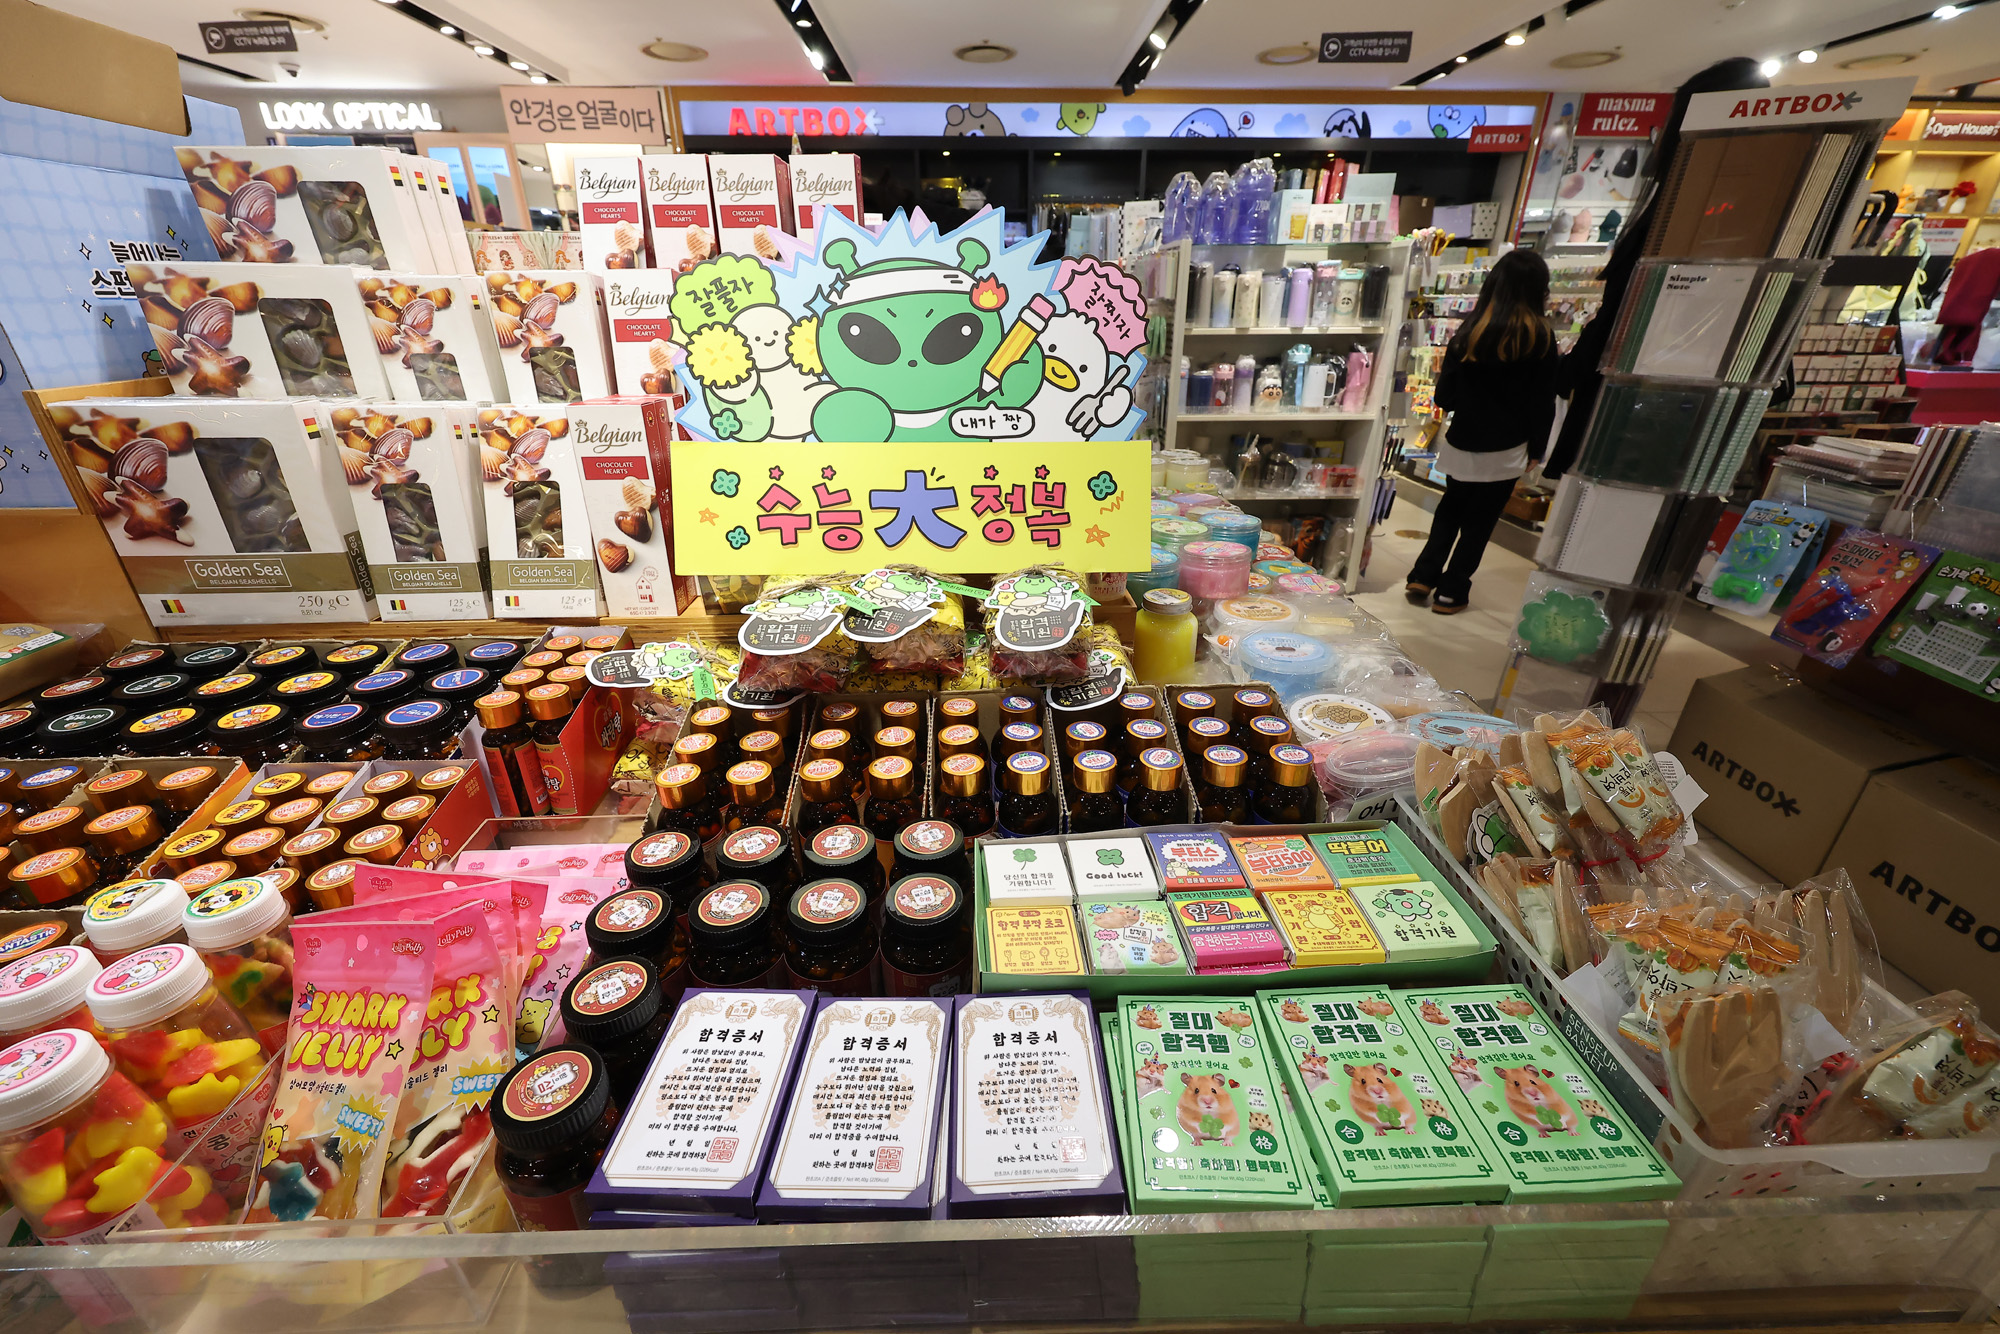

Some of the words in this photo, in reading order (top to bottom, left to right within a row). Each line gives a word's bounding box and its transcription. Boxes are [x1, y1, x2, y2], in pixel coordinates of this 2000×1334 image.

[1597, 97, 1656, 113] masma
[1729, 92, 1863, 118] ARTBOX
[259, 101, 332, 130] LOOK
[333, 101, 442, 130] OPTICAL
[510, 98, 577, 133] 안경은
[577, 100, 655, 133] 얼굴이다
[728, 106, 886, 136] ARTBOX
[1933, 122, 1959, 137] Orgel
[1963, 123, 1994, 135] House
[1473, 133, 1524, 145] ARTBOX
[579, 174, 637, 199] Belgian
[648, 173, 706, 202] Belgian
[716, 172, 774, 202] Belgian
[795, 173, 853, 202] Belgian
[594, 206, 636, 215] CHOCOLATE
[664, 209, 697, 217] CHOCOLATE
[1668, 274, 1707, 284] Simple
[686, 274, 754, 318] 잘풀자
[960, 415, 996, 431] 내가
[1003, 413, 1022, 435] 짱
[577, 423, 643, 453] Belgian
[756, 475, 864, 550] 수능
[971, 475, 1071, 548] 정복
[1838, 543, 1883, 562] 스파이더
[194, 562, 251, 578] Golden
[253, 562, 284, 576] Sea
[394, 571, 435, 581] Golden
[437, 569, 457, 580] Sea
[513, 567, 552, 577] Golden
[554, 568, 573, 576] Sea
[1937, 565, 1969, 581] 손가락
[358, 561, 374, 597] Golden
[299, 596, 324, 608] 250
[768, 624, 798, 633] 합격
[1020, 617, 1049, 629] 합격
[766, 634, 796, 643] 기원
[1022, 629, 1051, 639] 기원
[1691, 740, 1801, 818] ARTBOX
[1359, 800, 1387, 820] OH
[1171, 847, 1219, 857] 부터스
[1327, 840, 1390, 855] 딱붙어
[1248, 850, 1313, 874] 부터500
[1031, 872, 1054, 880] 합격을
[1086, 872, 1114, 880] Good
[1185, 901, 1232, 922] 합격
[998, 920, 1019, 930] 합격
[1023, 919, 1041, 929] 부적
[1045, 918, 1065, 928] 초코
[437, 924, 475, 947] LollyPolly
[1394, 926, 1457, 941] 합격기원
[391, 937, 426, 956] LollyPolly
[301, 991, 408, 1031] SHARK
[1312, 1003, 1359, 1022] 절대
[1450, 1003, 1501, 1023] 절대
[1169, 1012, 1213, 1031] 절대
[699, 1028, 764, 1044] 합격증서
[992, 1031, 1059, 1046] 합격증서
[1311, 1023, 1383, 1044] 합격햄
[1453, 1025, 1528, 1047] 합격햄
[843, 1036, 908, 1051] 합격증서
[1161, 1032, 1230, 1054] 합격햄
[1565, 1026, 1603, 1073] BASKET
[1568, 1013, 1618, 1073] SENSE-UP
[288, 1031, 383, 1075] JELLY
[691, 1048, 709, 1056] 사람은
[739, 1049, 765, 1058] 공부하고,
[1363, 1050, 1388, 1060] 걸어요
[1510, 1052, 1536, 1062] 걸어요
[433, 1064, 448, 1078] 젤리
[1205, 1062, 1230, 1071] 걸어요
[290, 1079, 316, 1092] 상어모양
[335, 1082, 347, 1094] 젤리
[692, 1075, 711, 1083] 뛰어난
[661, 1093, 688, 1101] 평소보다
[738, 1095, 751, 1103] 받아
[696, 1104, 716, 1112] 원하는
[719, 1104, 733, 1112] 곳에
[337, 1105, 385, 1139] SWEET!
[673, 1113, 693, 1121] 합격할
[695, 1113, 723, 1121] 것이기에
[673, 1123, 700, 1131] 합격증을
[703, 1124, 738, 1133] 수여합니다.
[1341, 1126, 1358, 1139] 合
[1435, 1122, 1452, 1136] 格
[1503, 1127, 1521, 1142] 合
[1597, 1121, 1617, 1136] 格
[669, 1139, 675, 1147] 년
[687, 1139, 693, 1147] 월
[1255, 1136, 1273, 1150] 格
[646, 1150, 665, 1158] 원하는
[667, 1150, 680, 1159] 곳에
